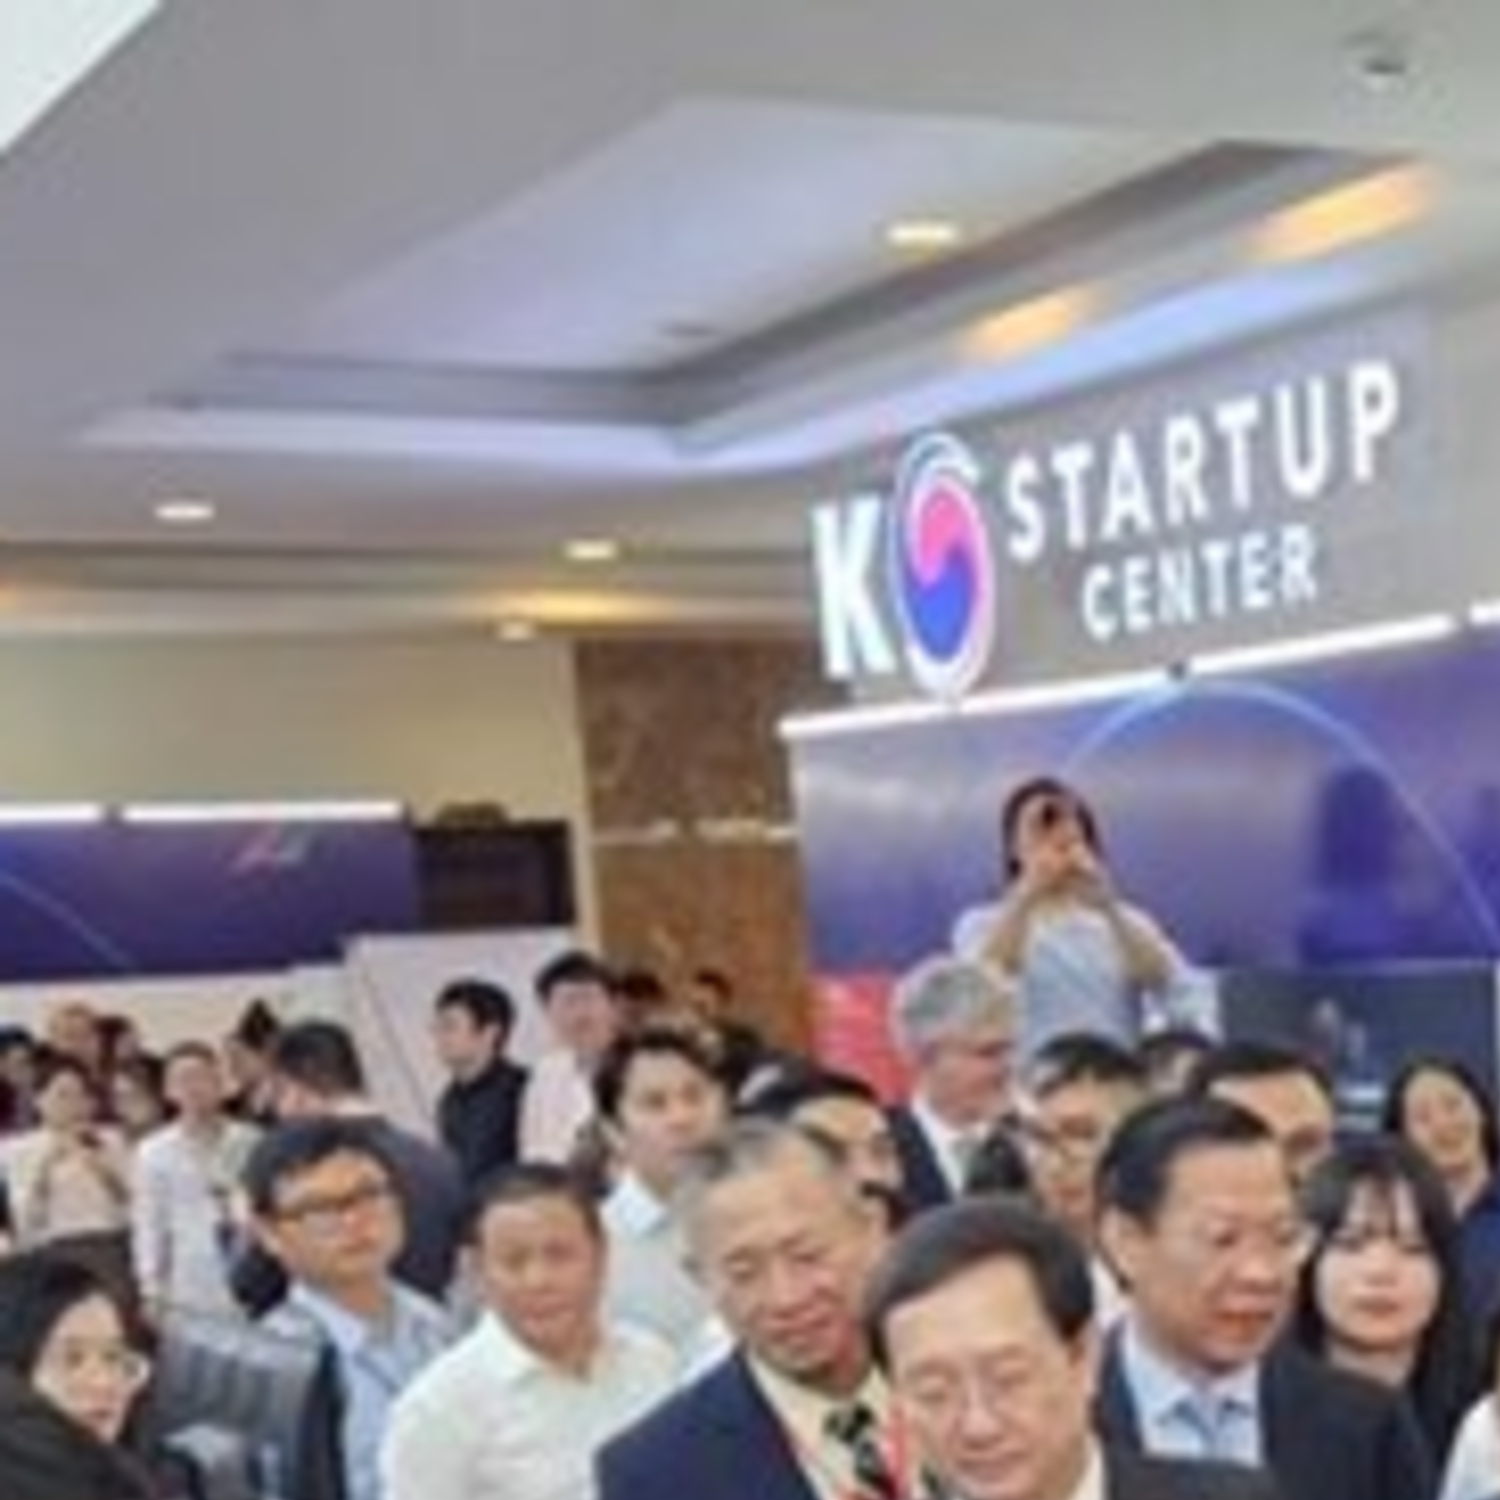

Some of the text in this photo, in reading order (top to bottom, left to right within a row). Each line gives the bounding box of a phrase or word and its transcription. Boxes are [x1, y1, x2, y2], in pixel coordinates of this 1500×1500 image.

[812, 360, 1400, 684] K STARTUP
[1082, 524, 1319, 640] CENTER
